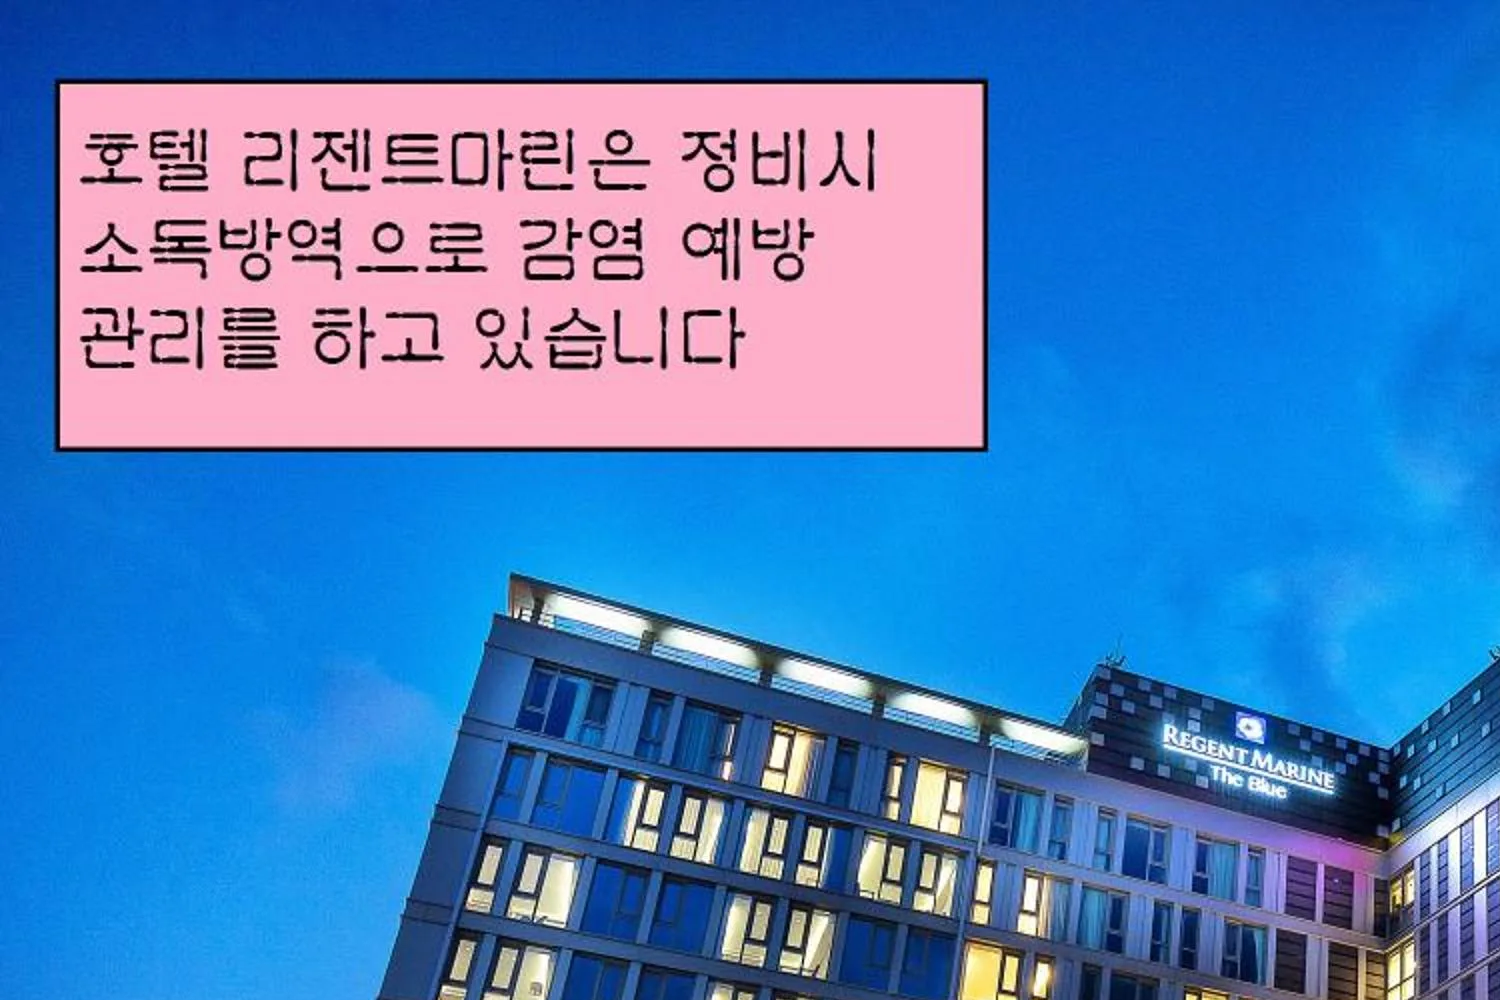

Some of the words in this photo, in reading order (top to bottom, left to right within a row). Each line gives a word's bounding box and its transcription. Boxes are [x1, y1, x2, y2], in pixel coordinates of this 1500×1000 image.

[1163, 723, 1249, 763] REGENT
[1251, 749, 1336, 790] MARINE
[1211, 765, 1244, 787] The
[1249, 777, 1288, 800] Blue
